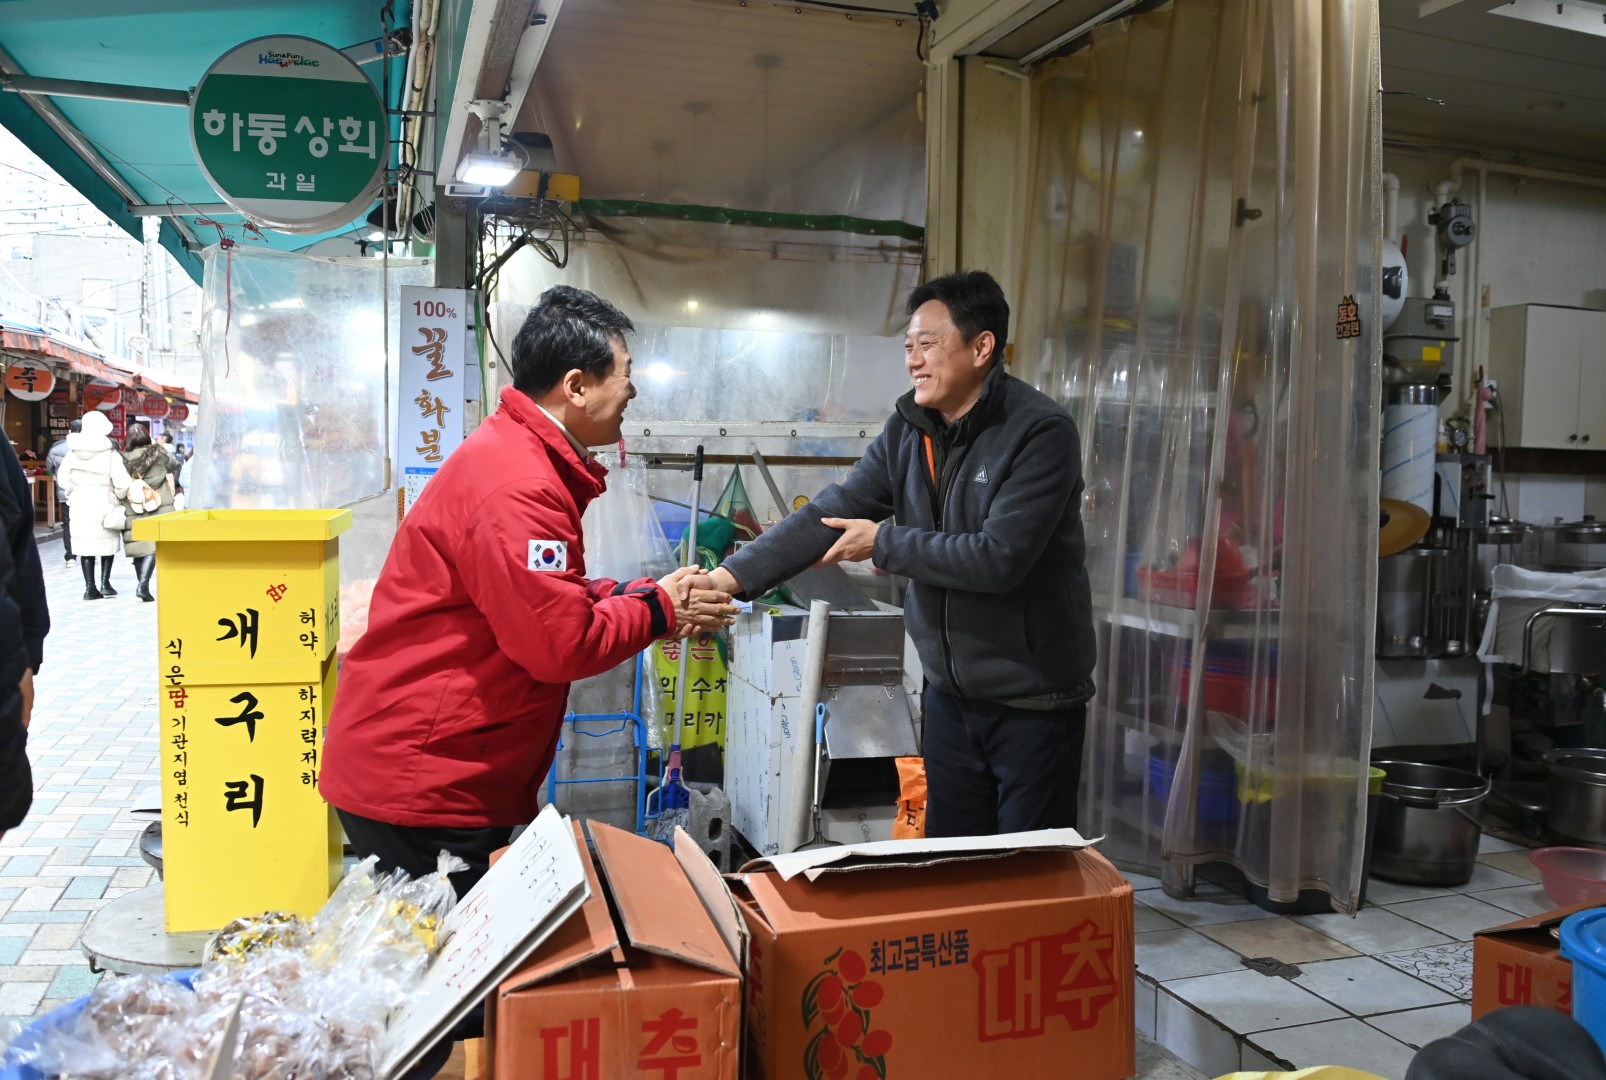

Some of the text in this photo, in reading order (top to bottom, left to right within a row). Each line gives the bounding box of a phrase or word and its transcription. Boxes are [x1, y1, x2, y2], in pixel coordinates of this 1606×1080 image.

[258, 53, 320, 68] Haeundae
[202, 108, 376, 159] 하동상회
[413, 300, 457, 318] 100%
[13, 366, 39, 393] 죽
[214, 608, 264, 828] 개구리
[174, 791, 189, 827] 천식
[869, 929, 969, 975] 최고급특산품
[977, 920, 1117, 1041] 대추
